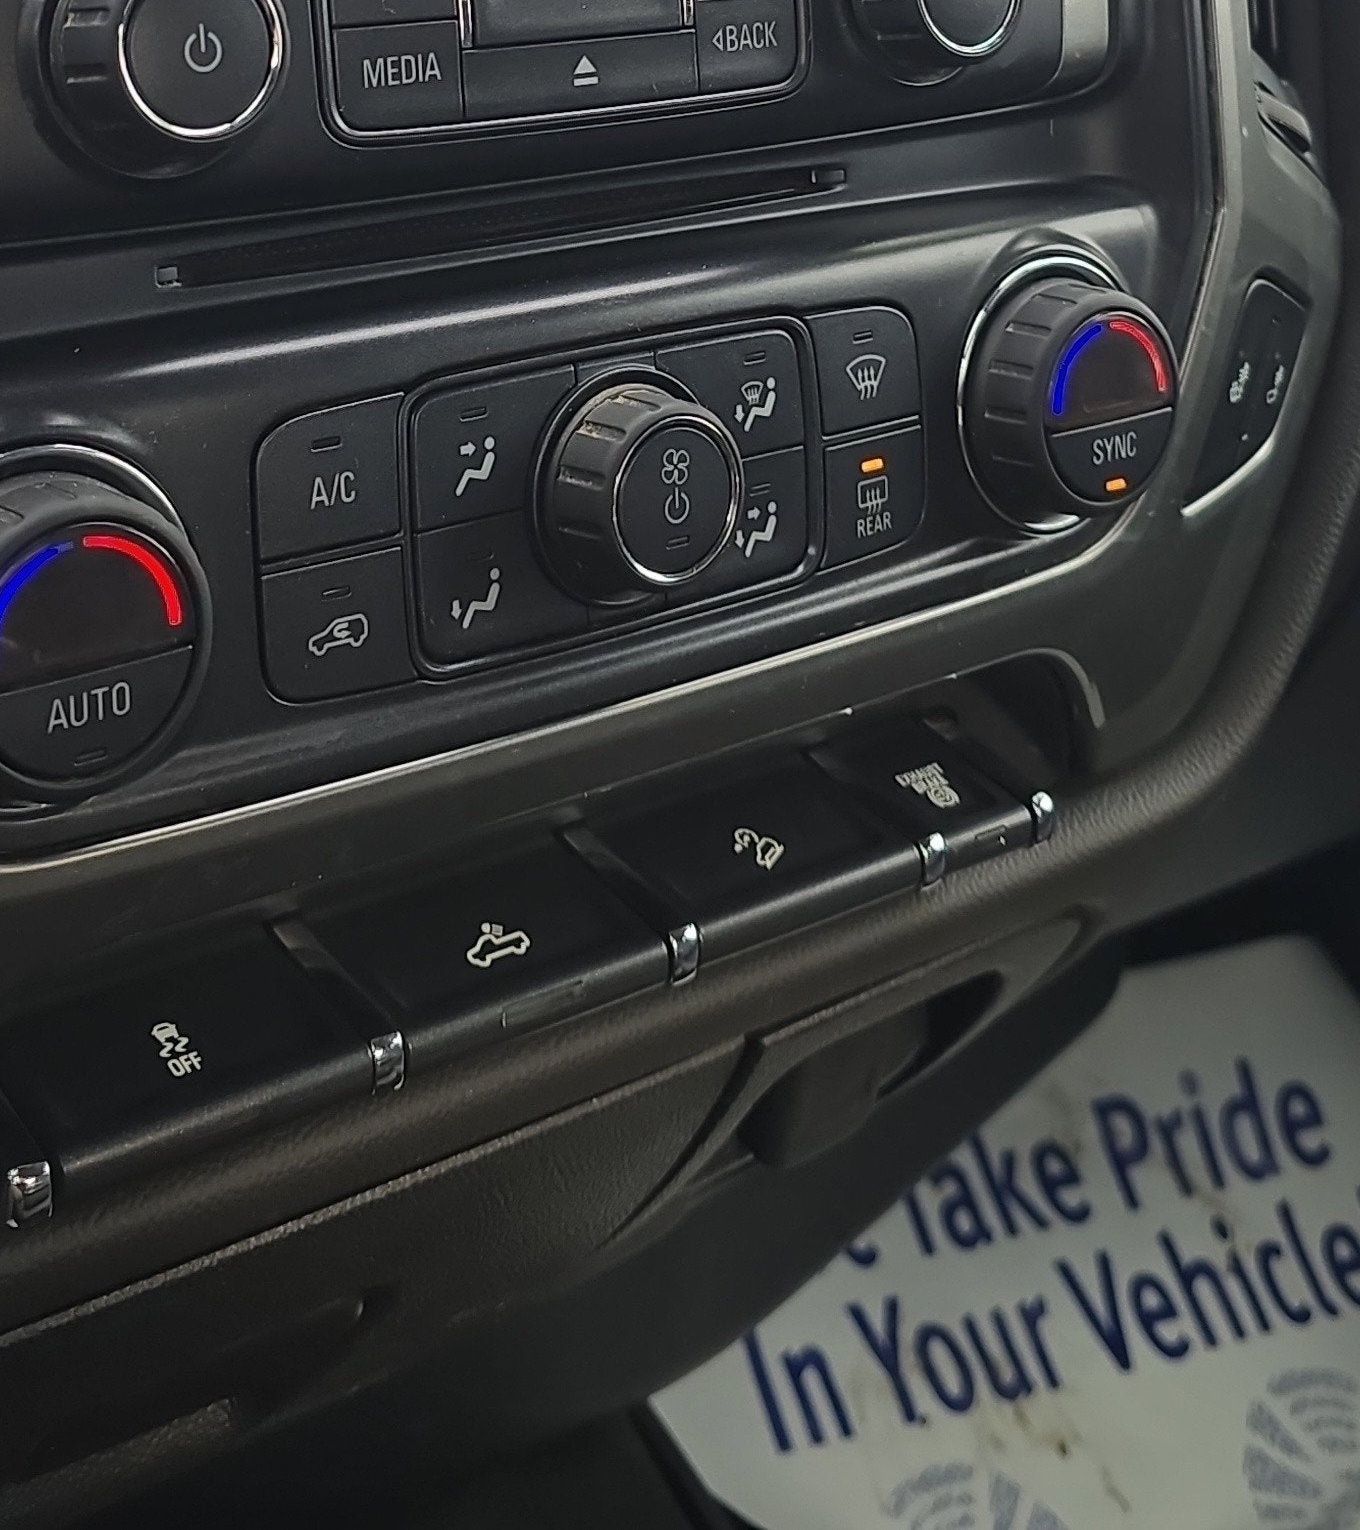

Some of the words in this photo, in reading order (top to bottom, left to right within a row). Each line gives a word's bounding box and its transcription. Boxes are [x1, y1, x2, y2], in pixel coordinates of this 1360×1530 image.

[725, 20, 778, 54] BACK
[362, 54, 442, 90] MEDIA
[1091, 429, 1138, 466] SYNC
[309, 470, 357, 510] A/C
[856, 511, 893, 538] REAR
[46, 680, 132, 734] AUTO
[167, 1051, 202, 1077] OFF
[1092, 1056, 1332, 1211] Pride
[741, 1326, 854, 1454] In
[845, 1294, 1063, 1426] Your
